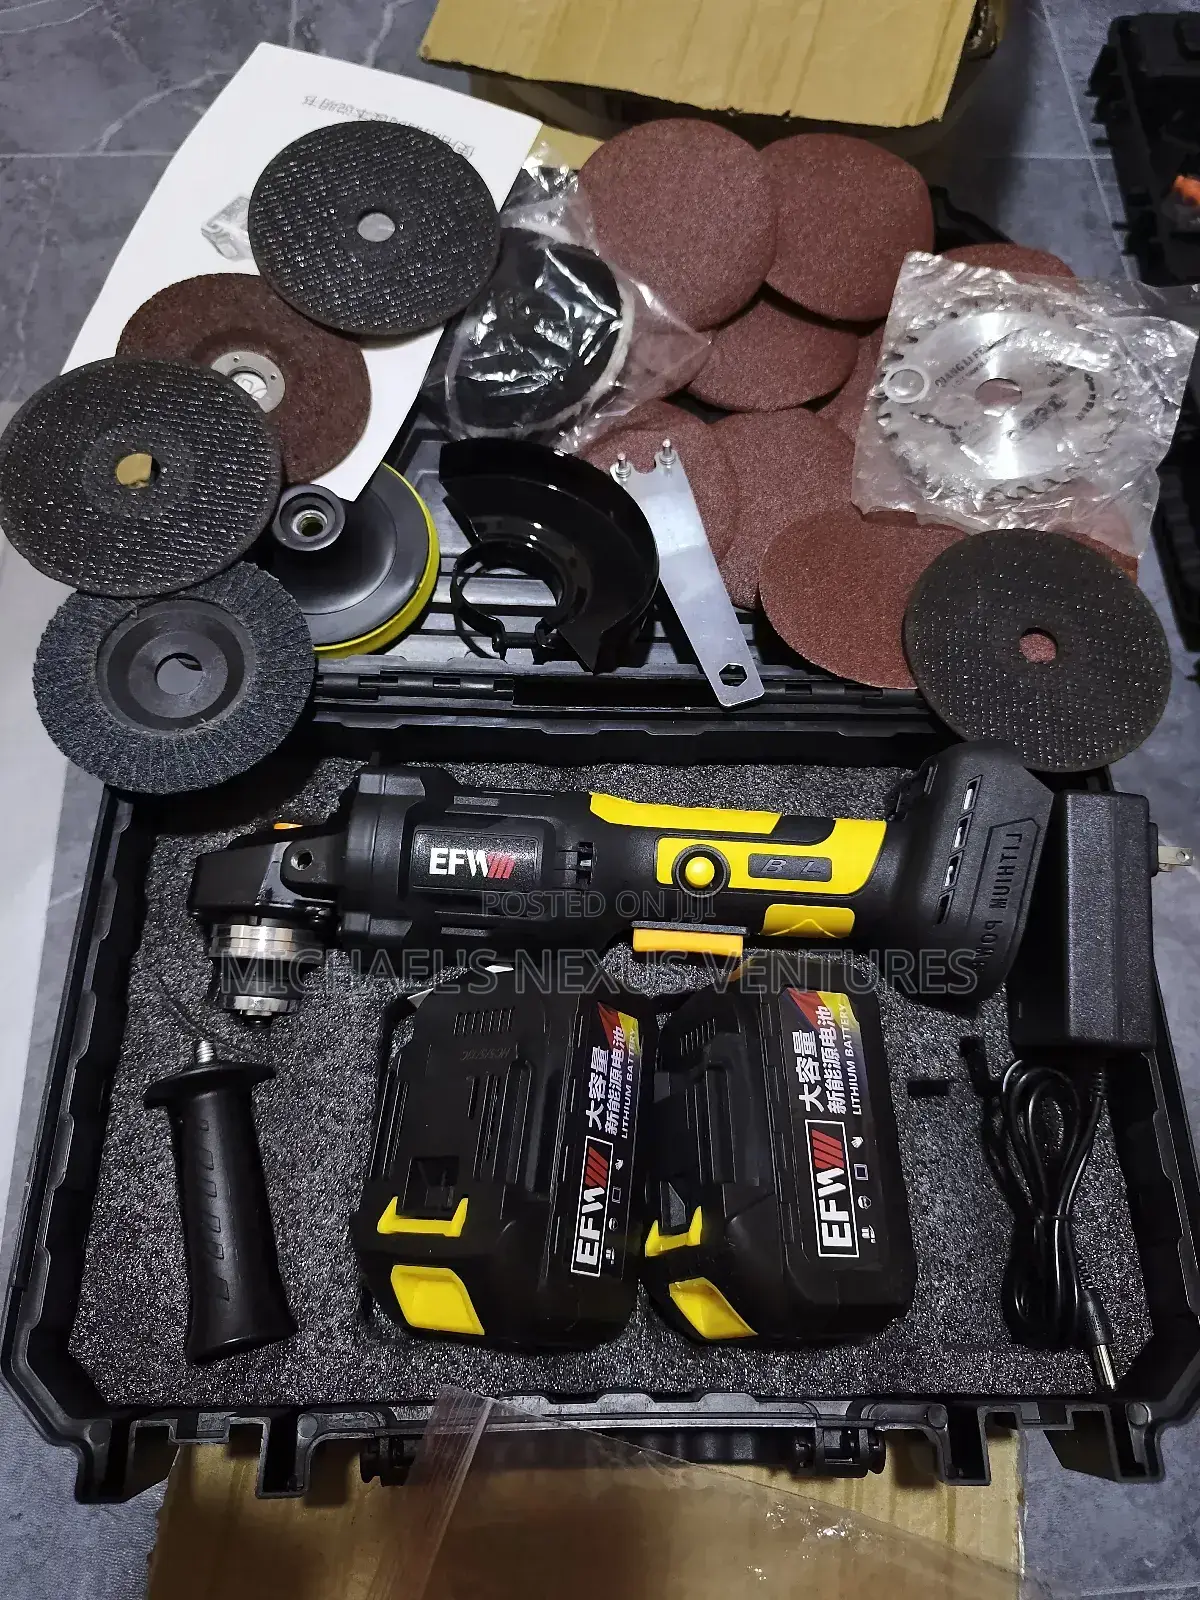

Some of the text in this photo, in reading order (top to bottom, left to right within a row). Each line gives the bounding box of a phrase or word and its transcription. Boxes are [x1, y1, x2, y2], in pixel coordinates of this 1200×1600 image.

[428, 847, 496, 880] EFW
[586, 1046, 609, 1131] 大容量
[605, 1025, 626, 1136] 新能源电池
[621, 1028, 636, 1139] LITHIUM BATTERY
[792, 1029, 825, 1113] 大容量
[815, 1005, 847, 1115] 新能源电池
[838, 1003, 862, 1116] LITHIUM BATTERY
[576, 1175, 606, 1266] EFW
[815, 1158, 853, 1247] EFW
